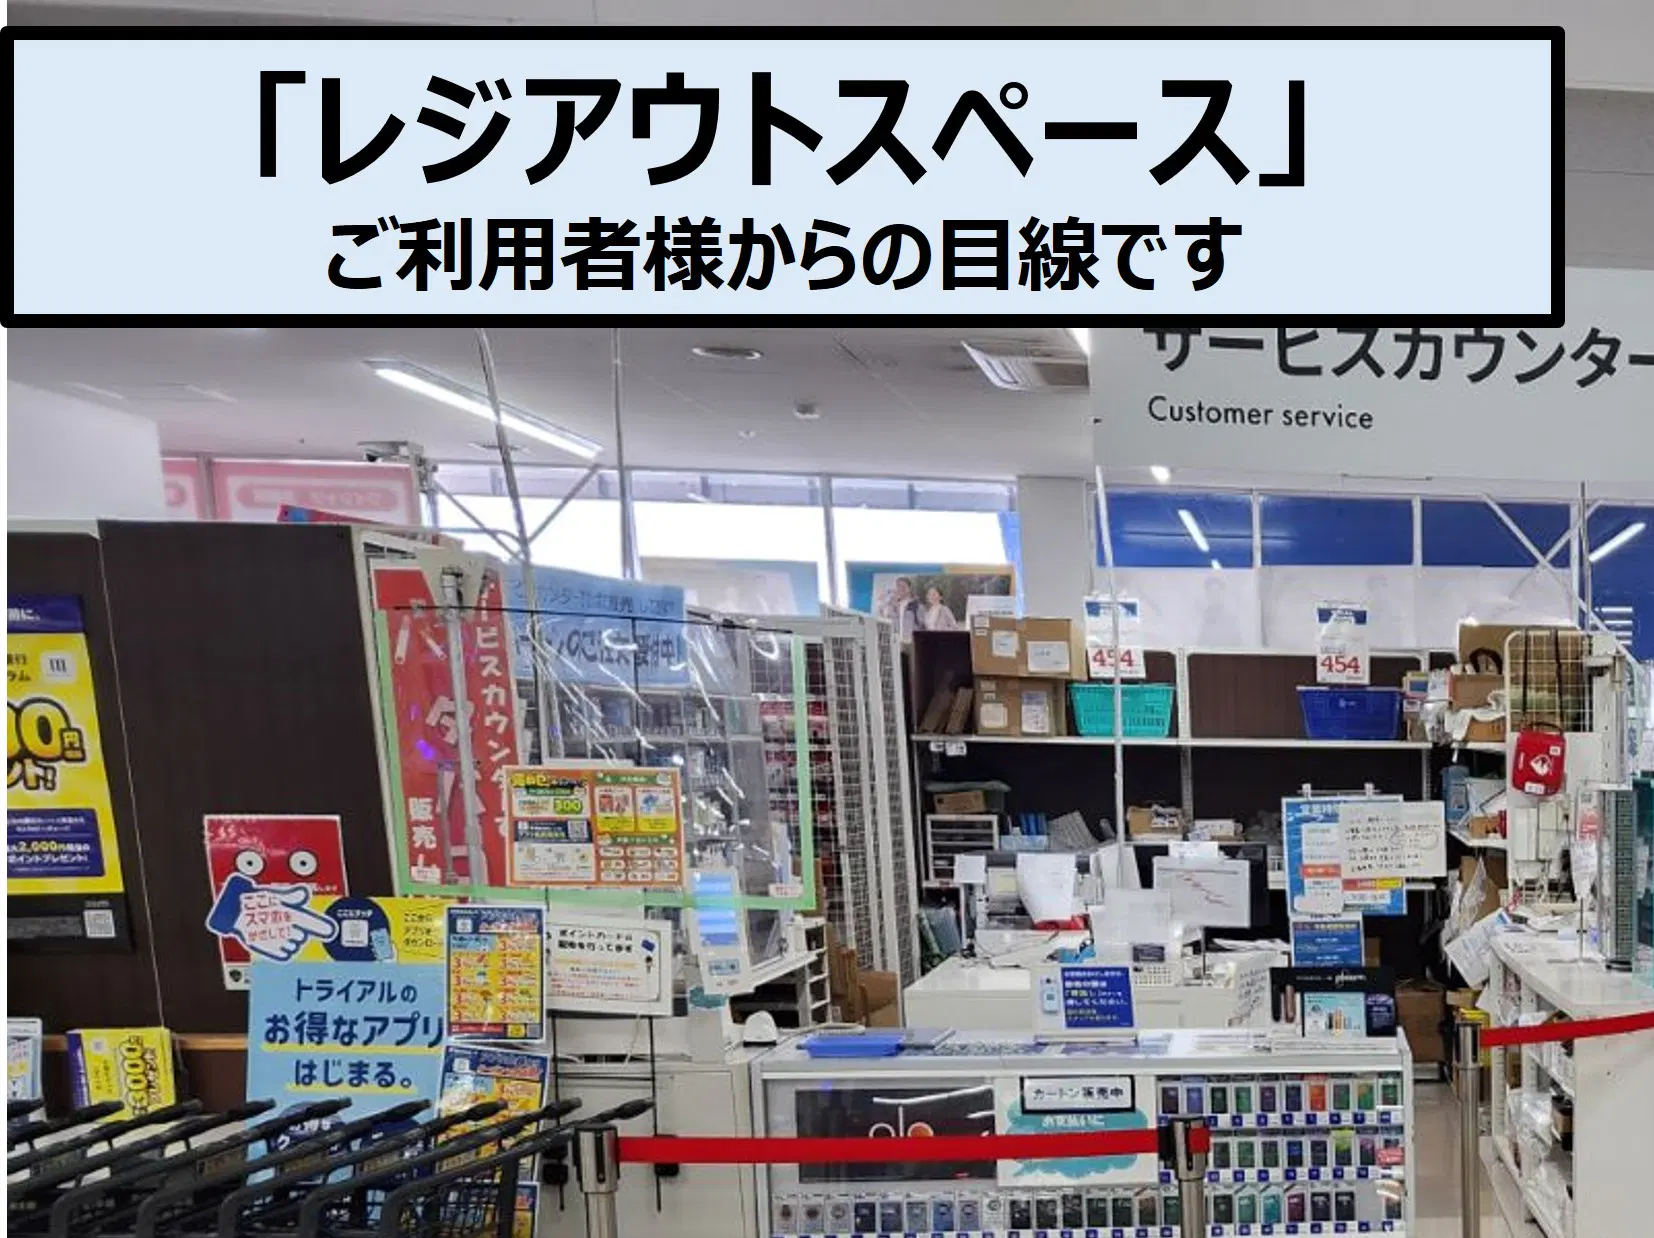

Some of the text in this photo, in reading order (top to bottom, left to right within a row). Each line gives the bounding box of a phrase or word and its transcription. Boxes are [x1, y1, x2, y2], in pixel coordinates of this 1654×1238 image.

[1147, 395, 1375, 430] Customer service
[1320, 655, 1361, 675] 454
[245, 910, 293, 927] スマホを
[295, 977, 419, 1004] トライアルの
[263, 1009, 444, 1049] お得なアプリ
[294, 1058, 413, 1089] はじまる。
